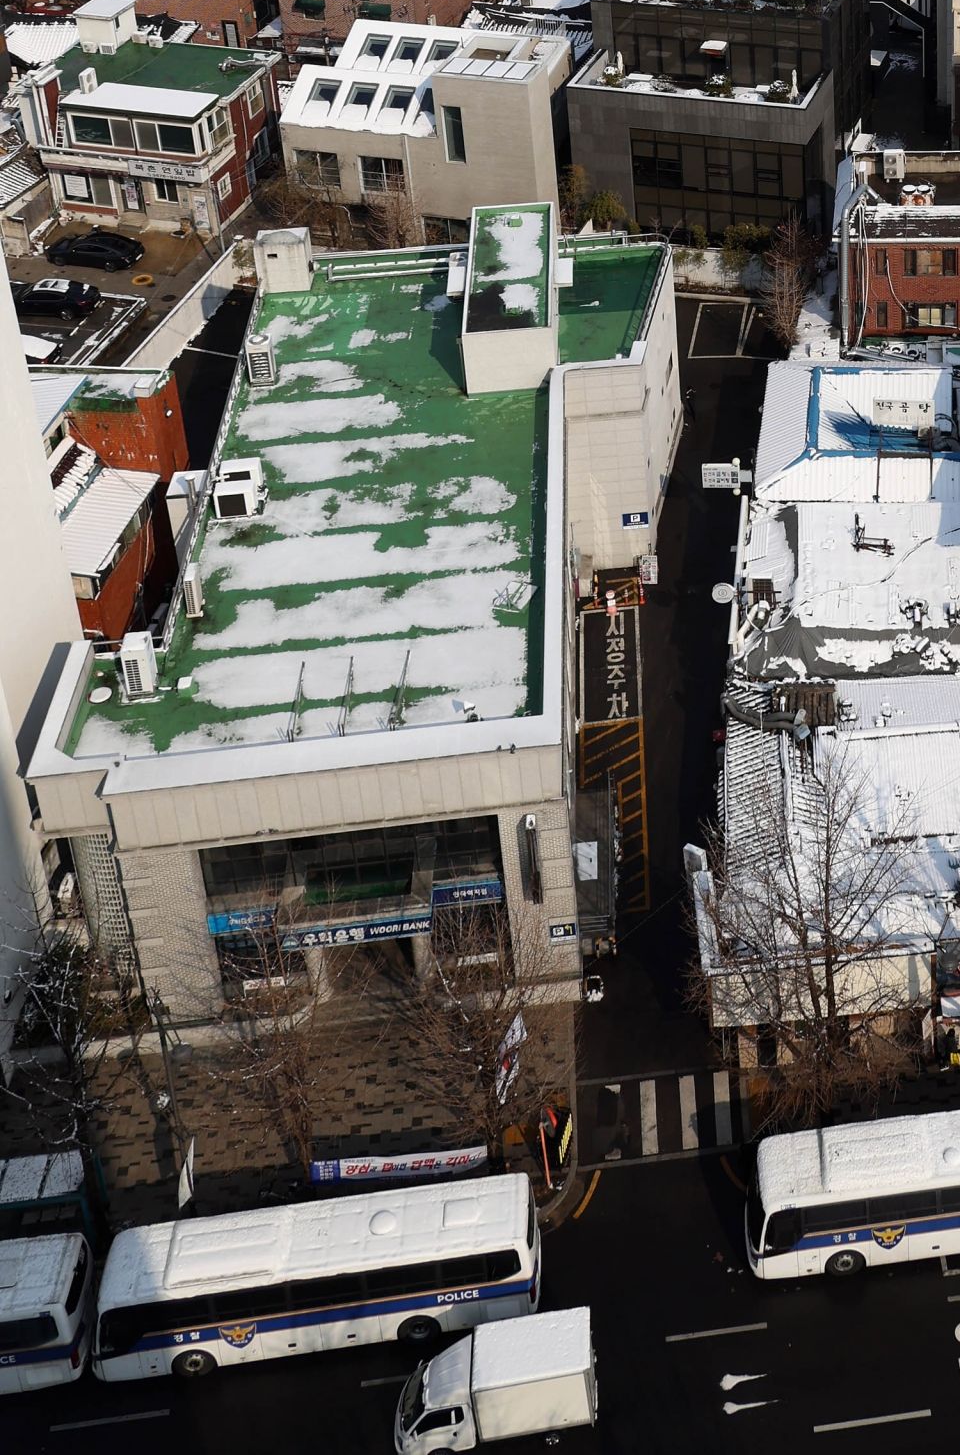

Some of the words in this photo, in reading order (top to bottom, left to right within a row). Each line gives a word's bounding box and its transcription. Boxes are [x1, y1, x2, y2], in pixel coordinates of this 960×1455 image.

[135, 163, 157, 173] 북촌
[162, 166, 196, 178] 연잎밥
[302, 927, 365, 945] 우리은행
[369, 925, 402, 936] WOORI
[402, 921, 431, 932] BANK
[833, 1232, 857, 1243] 경찰
[437, 1289, 480, 1303] POLICE
[173, 1331, 200, 1343] 경찰
